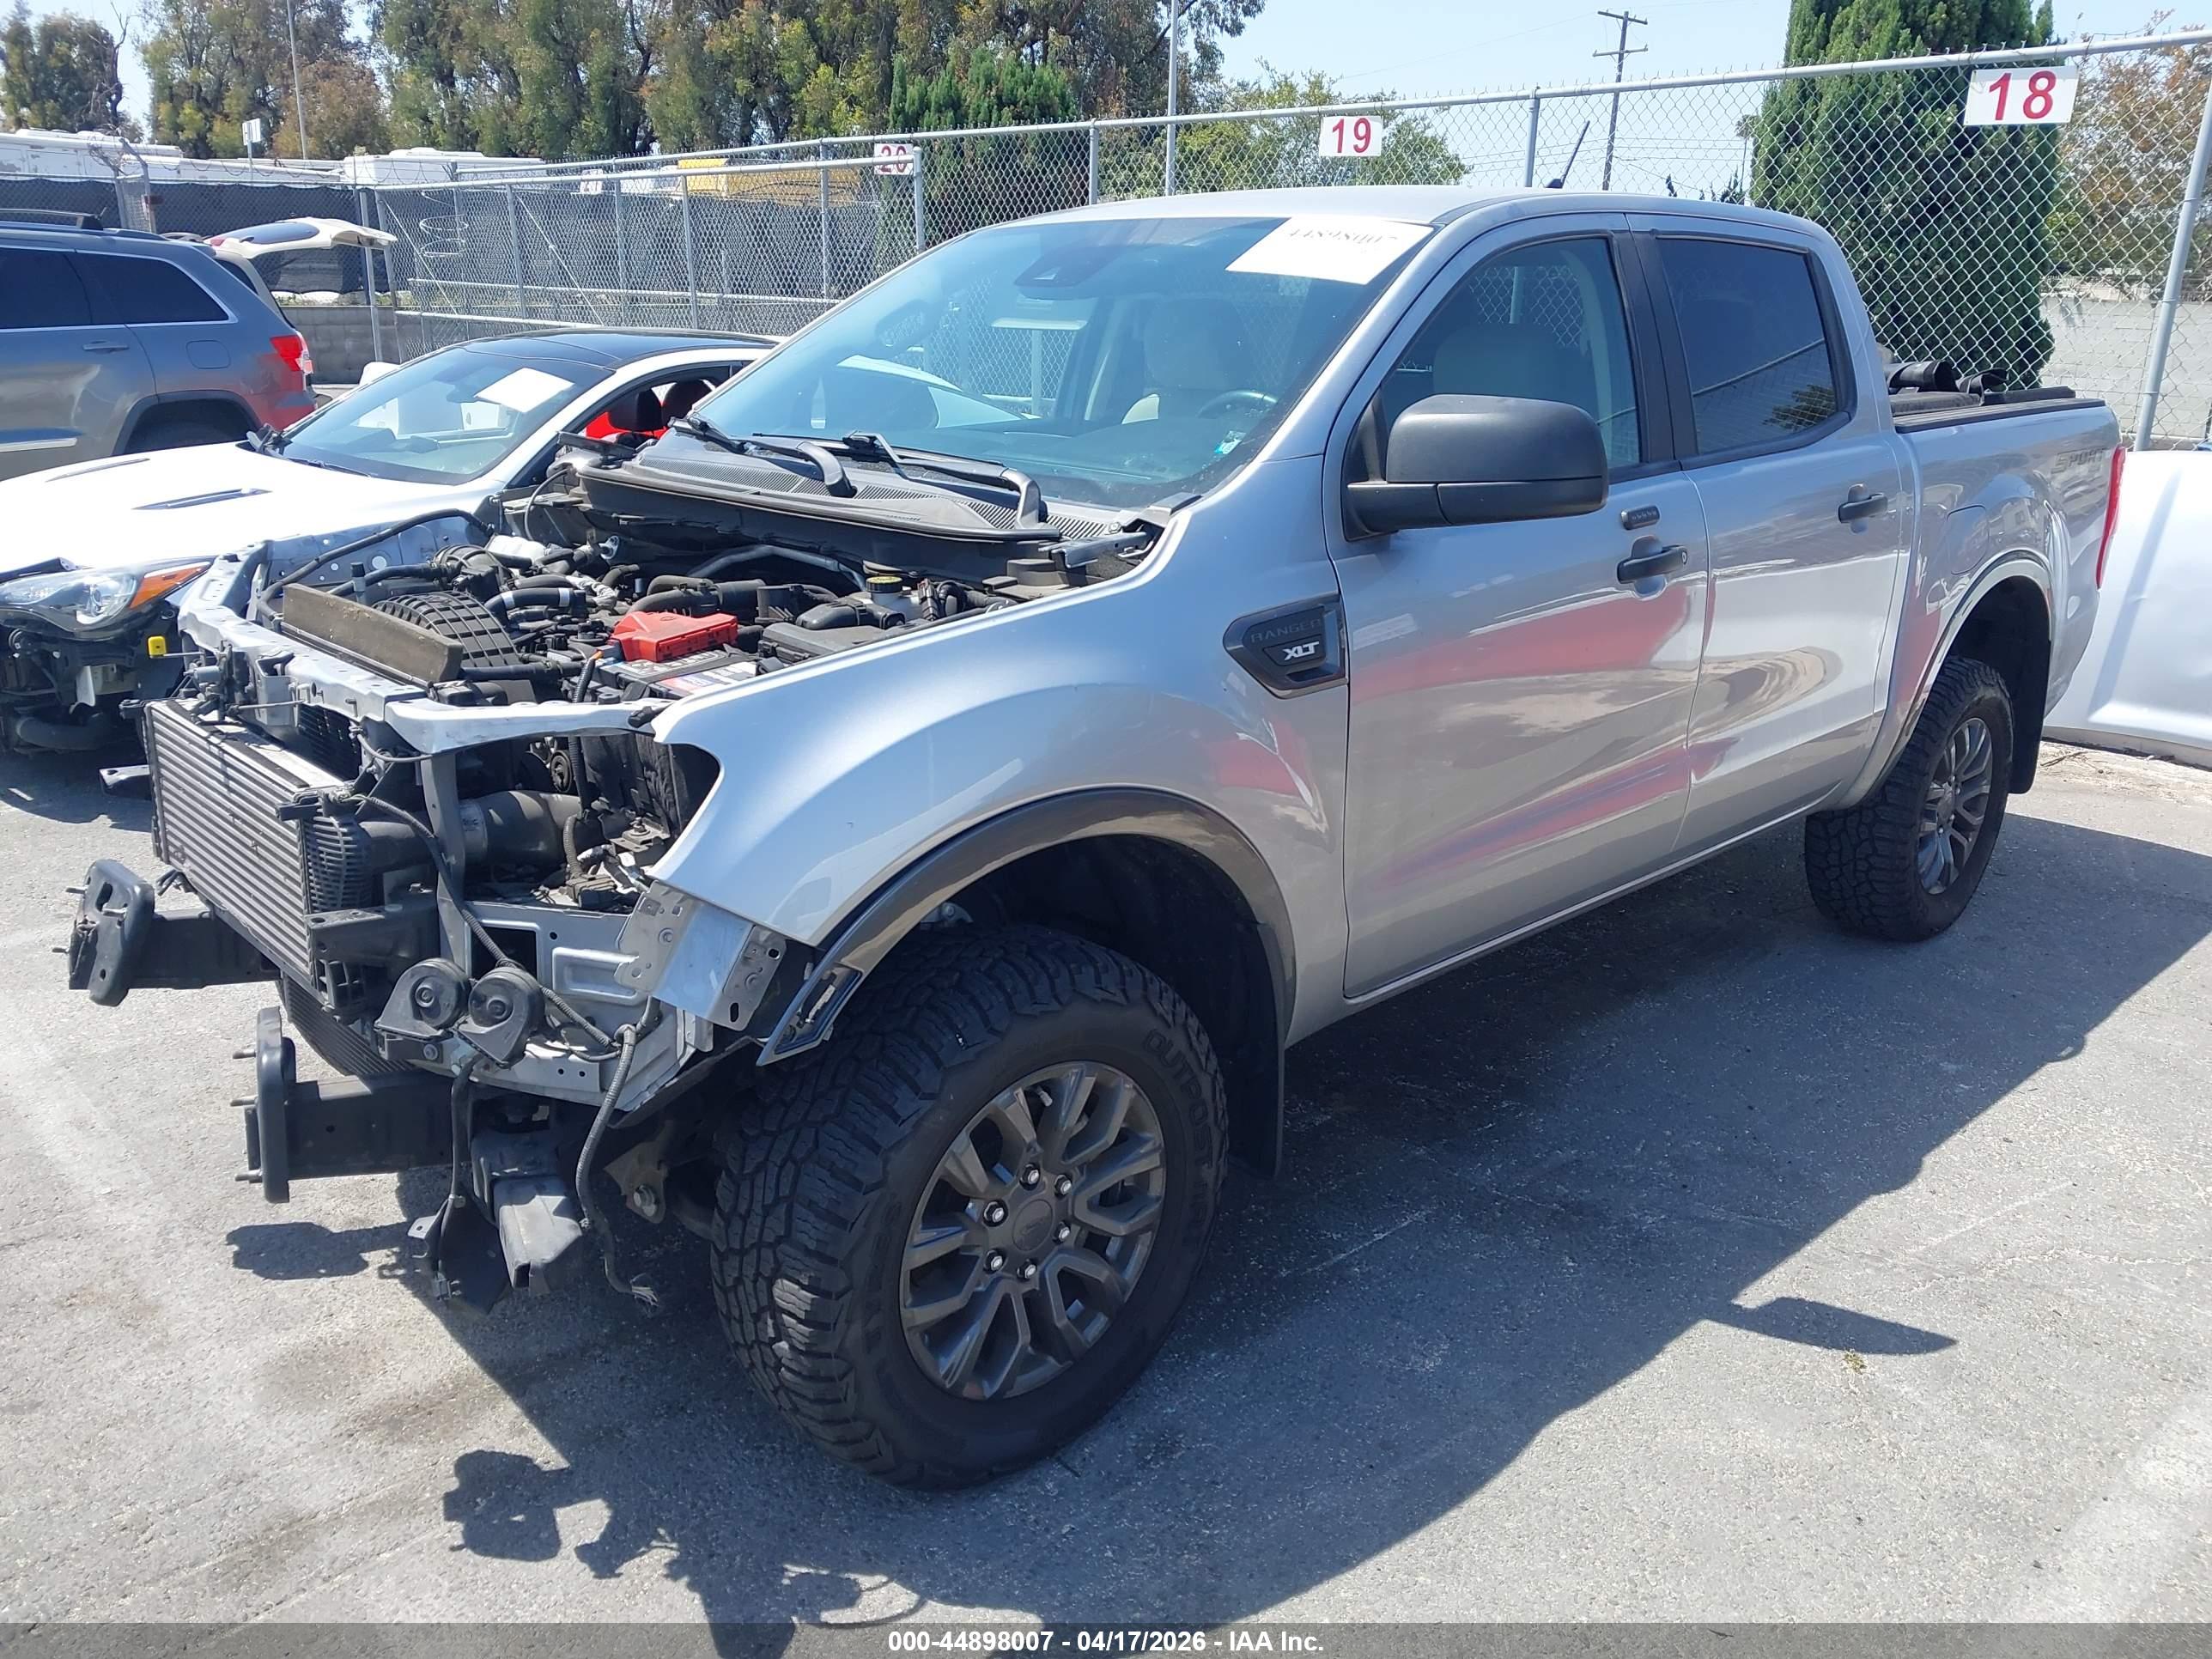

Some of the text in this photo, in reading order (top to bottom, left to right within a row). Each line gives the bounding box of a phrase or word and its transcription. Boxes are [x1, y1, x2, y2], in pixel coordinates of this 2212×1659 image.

[1989, 70, 2057, 121] 18
[1332, 117, 1371, 154] 19
[880, 144, 908, 173] 20
[1250, 618, 1322, 642] RANGER
[1282, 641, 1320, 661] XLT
[1142, 1028, 1214, 1169] OUTPOST
